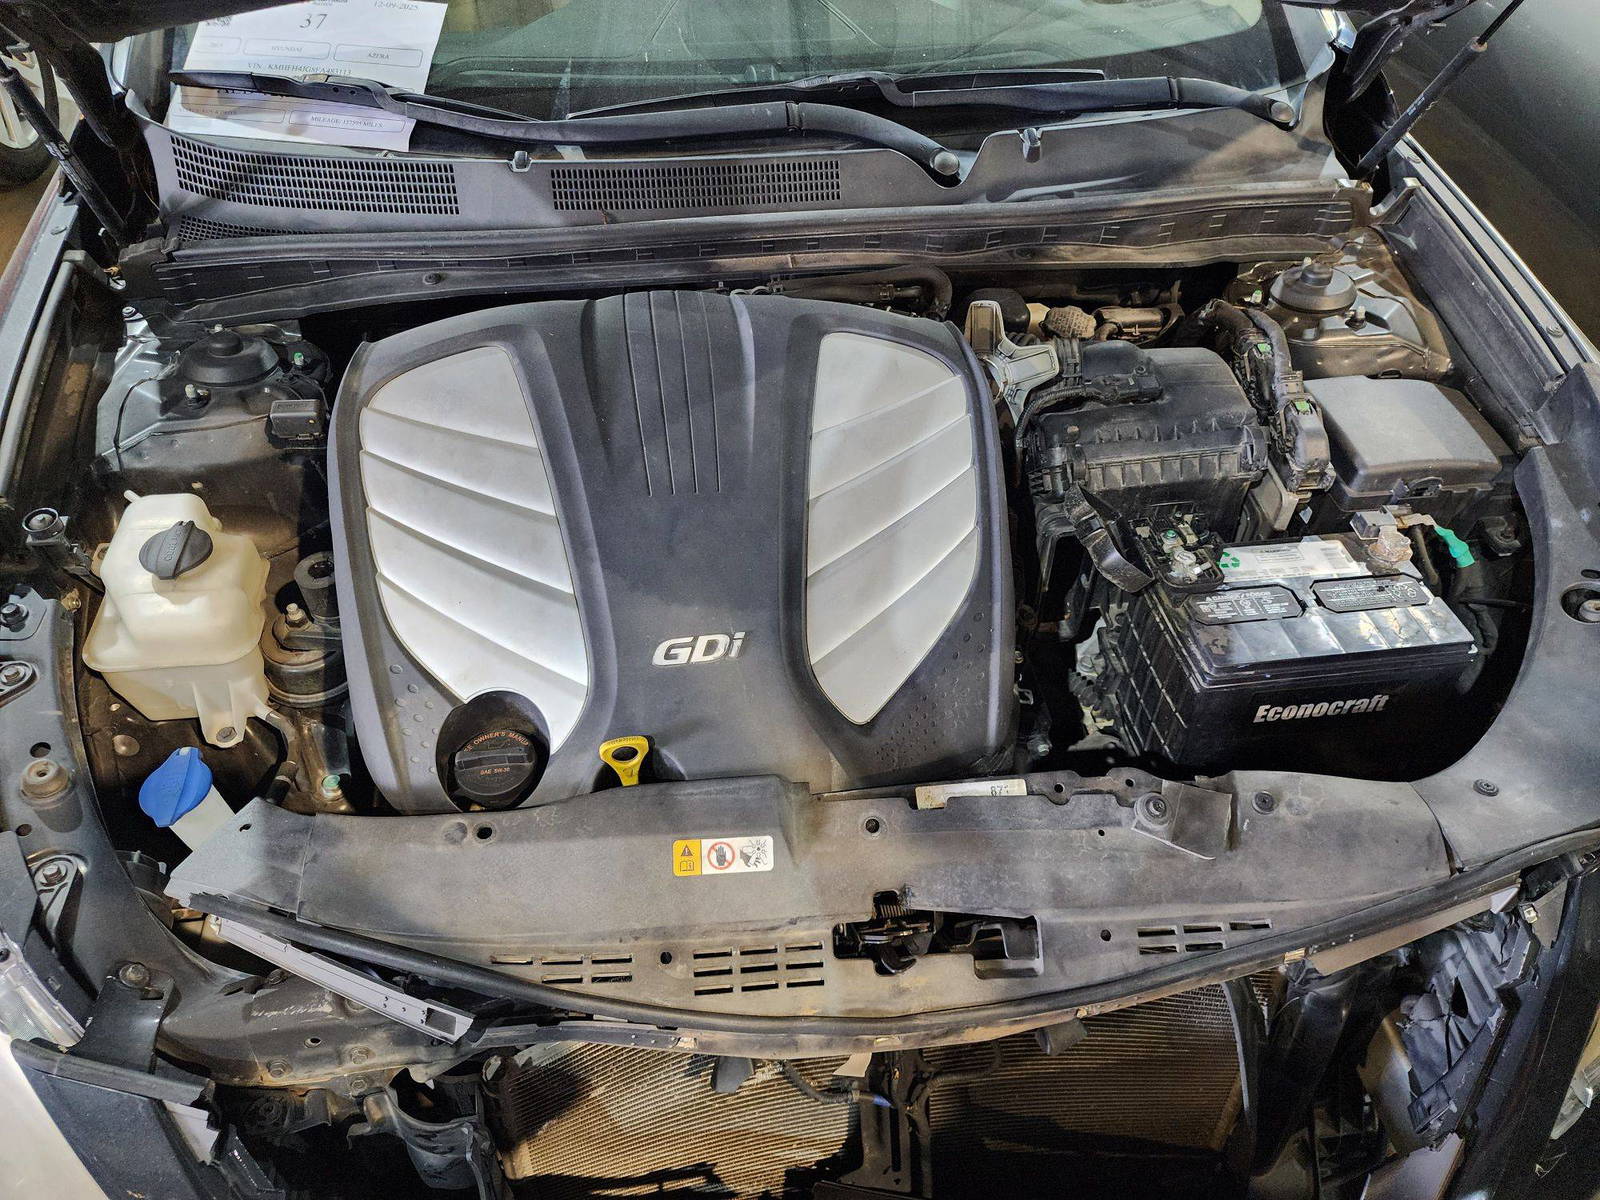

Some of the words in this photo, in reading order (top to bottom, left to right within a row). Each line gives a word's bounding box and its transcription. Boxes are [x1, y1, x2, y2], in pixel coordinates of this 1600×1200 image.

[299, 13, 328, 29] 37
[652, 632, 745, 666] GDi
[1253, 694, 1390, 723] Econocraft
